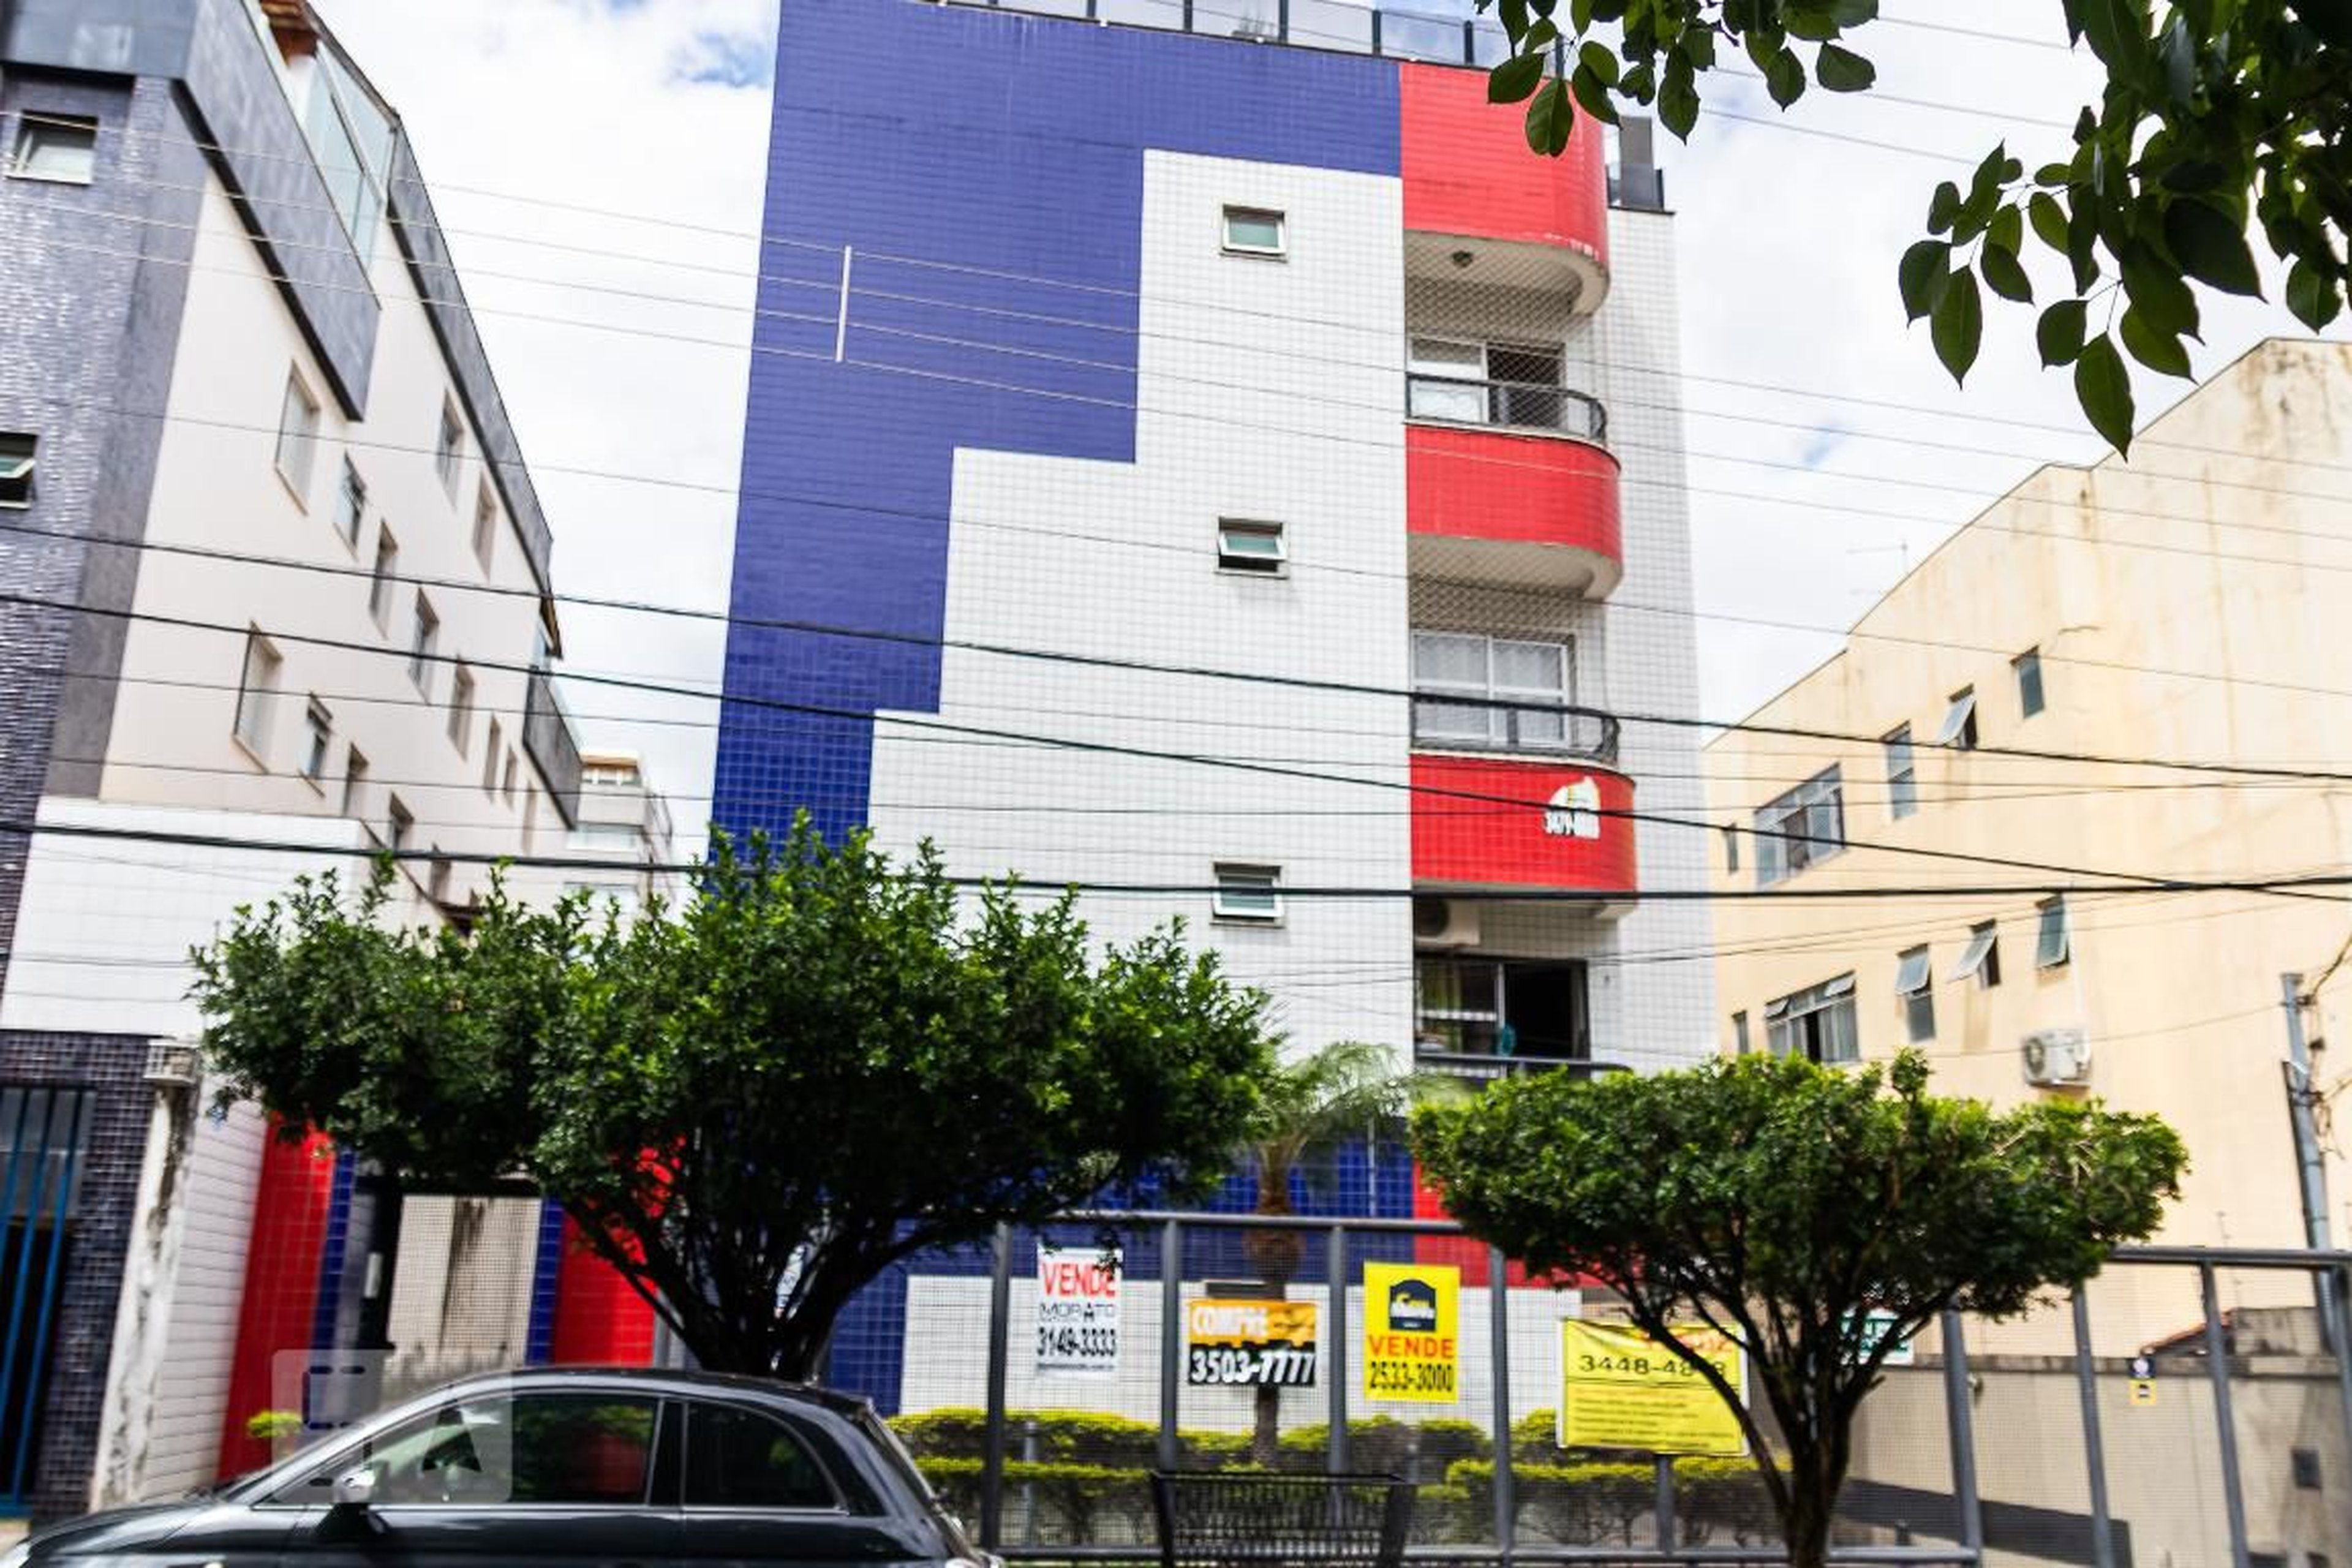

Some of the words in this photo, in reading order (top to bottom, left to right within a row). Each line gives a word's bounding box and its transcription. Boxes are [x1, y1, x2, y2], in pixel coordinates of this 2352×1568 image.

[1041, 1262, 1116, 1298] VENDE
[1368, 1335, 1454, 1359] VENDE
[1191, 1349, 1315, 1384] 3503-7777
